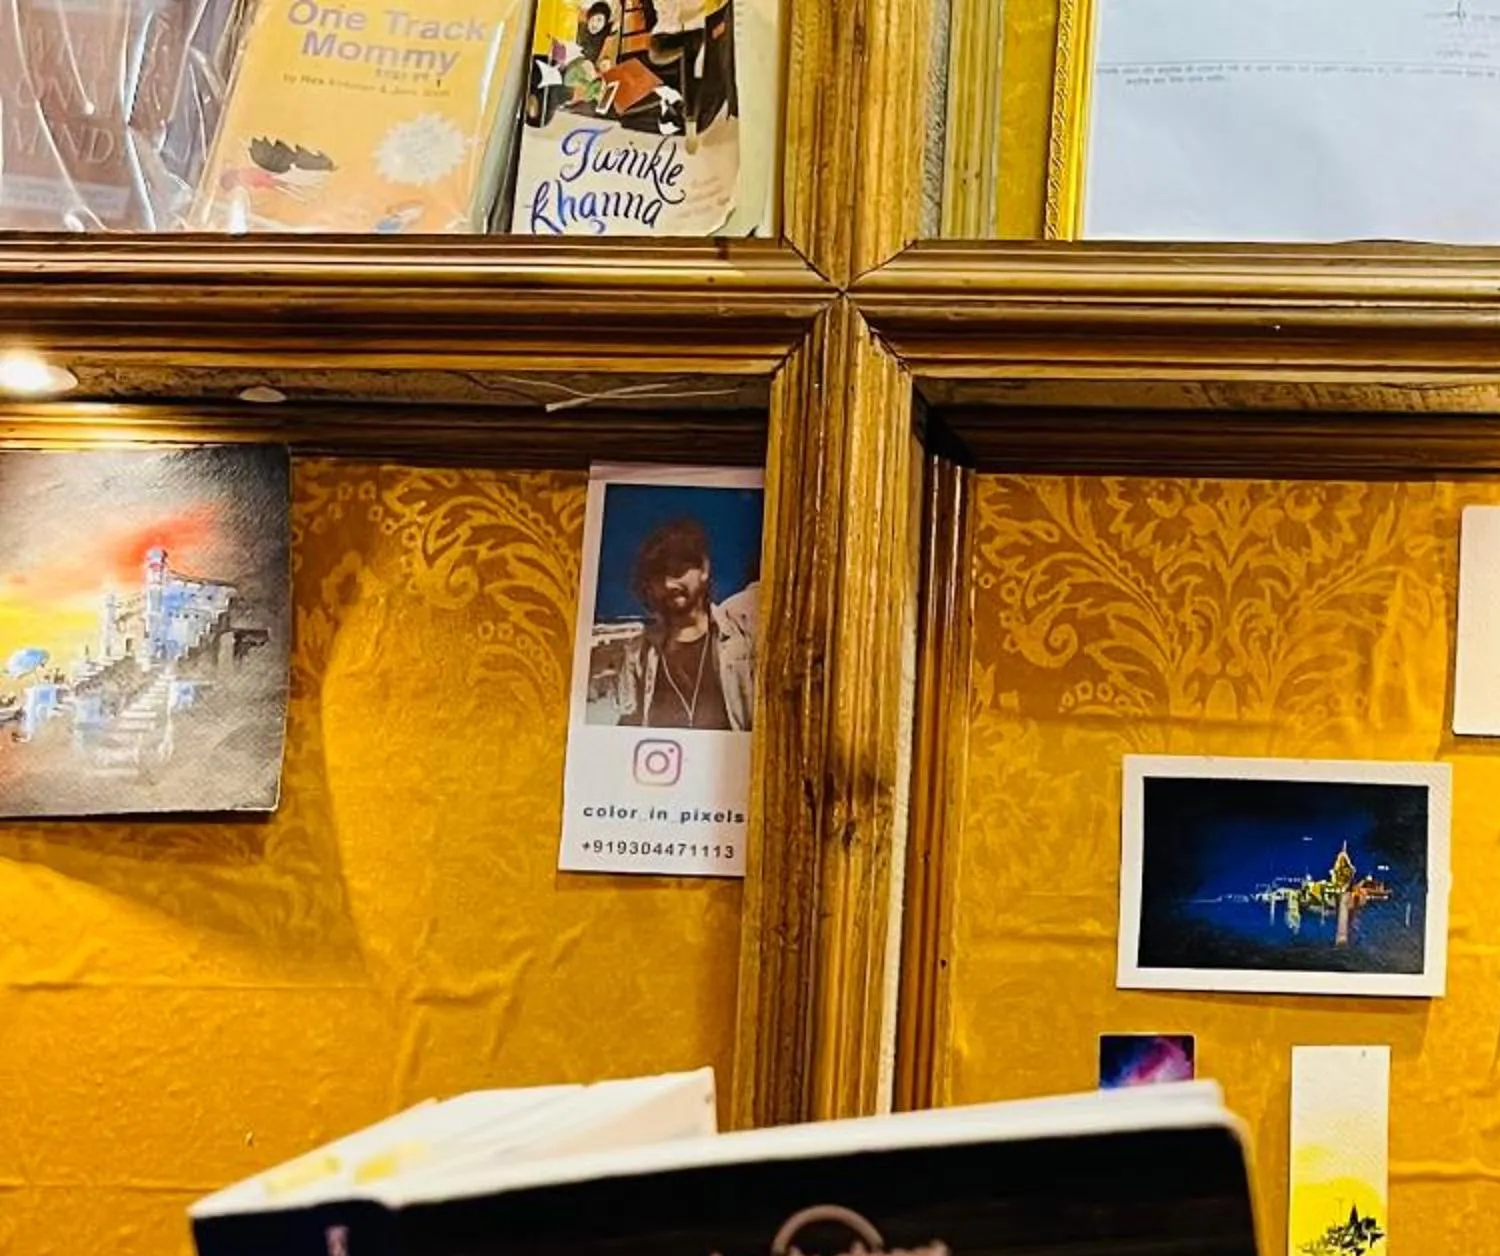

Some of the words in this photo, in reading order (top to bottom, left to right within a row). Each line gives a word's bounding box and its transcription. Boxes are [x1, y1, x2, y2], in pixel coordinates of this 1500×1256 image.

[288, 0, 368, 31] One
[384, 9, 487, 42] Track
[301, 30, 462, 76] Mommy
[559, 126, 688, 205] Twinkle
[530, 178, 663, 235] Khanna
[581, 839, 735, 859] +919304471113
